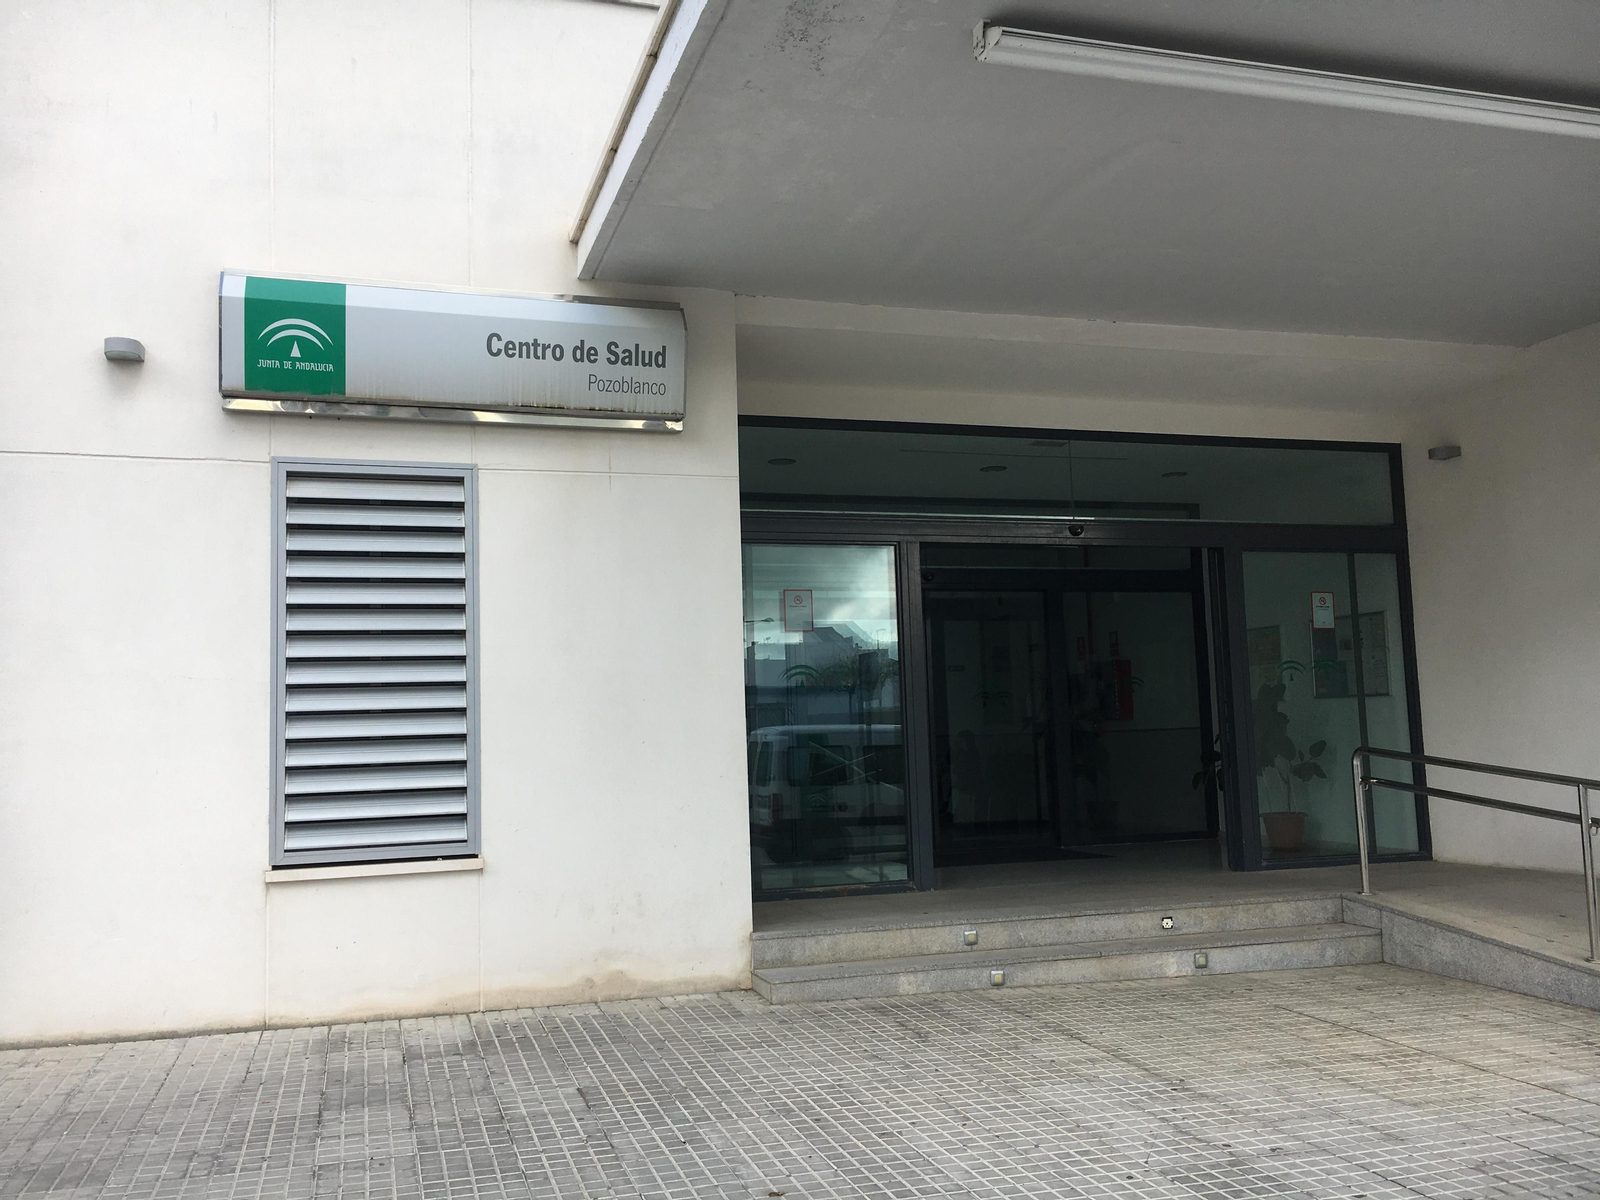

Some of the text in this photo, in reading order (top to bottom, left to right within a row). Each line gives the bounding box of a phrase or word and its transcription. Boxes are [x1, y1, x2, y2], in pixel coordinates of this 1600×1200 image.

[486, 332, 667, 368] Centro de Salud
[257, 359, 334, 372] JUNTA DE ANDALUCIA
[588, 373, 667, 396] Pozoblanco
